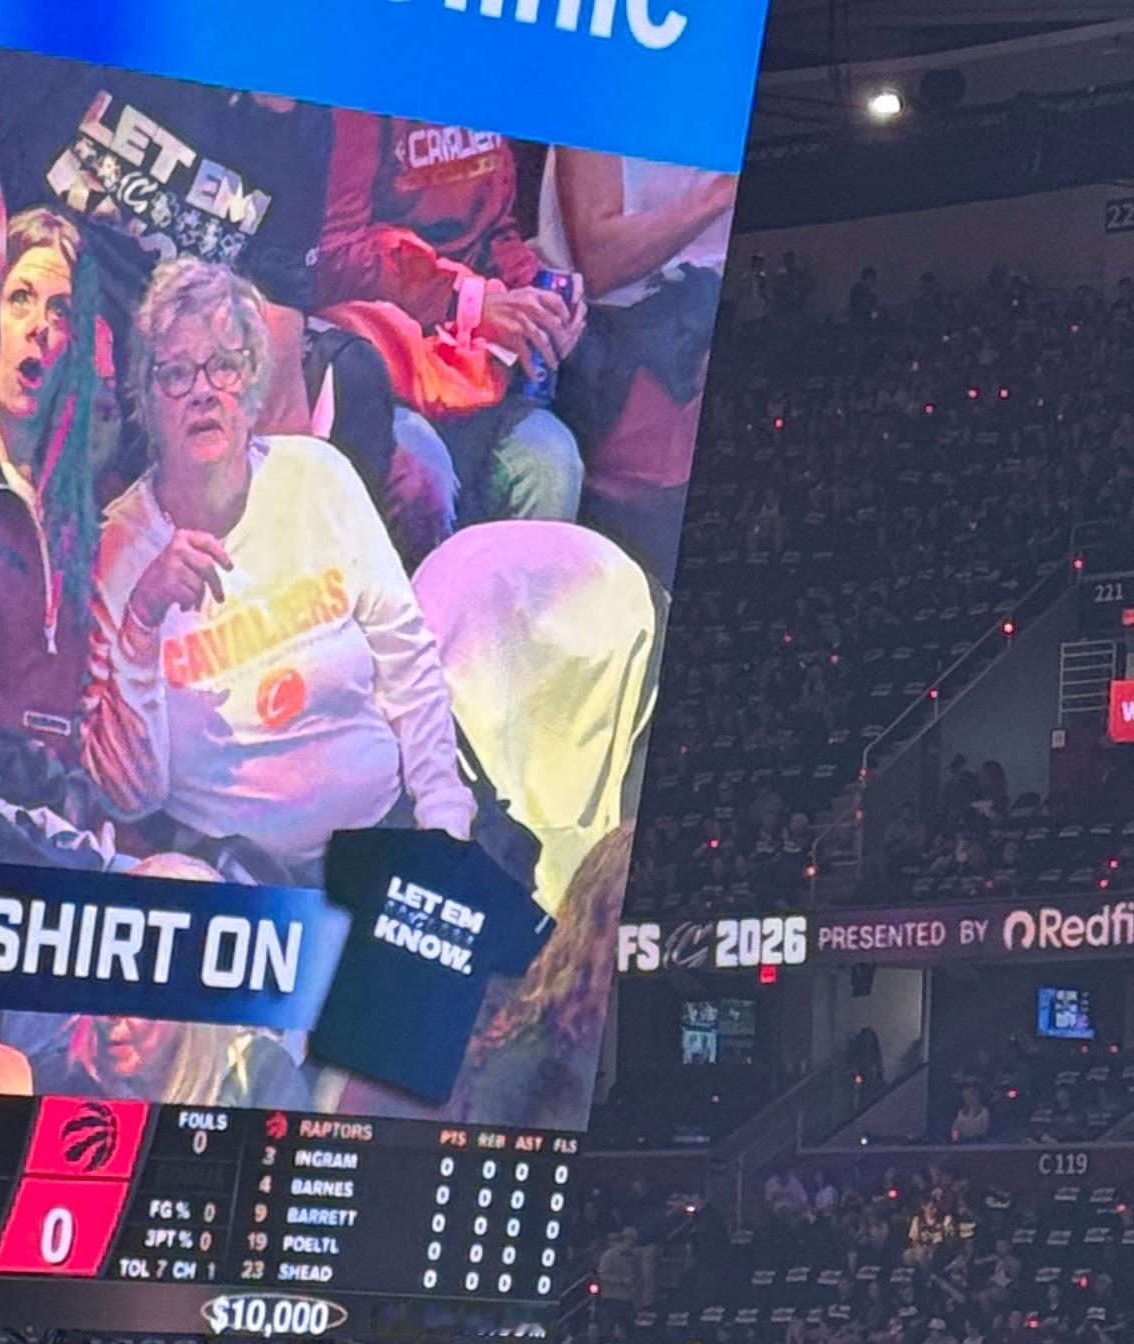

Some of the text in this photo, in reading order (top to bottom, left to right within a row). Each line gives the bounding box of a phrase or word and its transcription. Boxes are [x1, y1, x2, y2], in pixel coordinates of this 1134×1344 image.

[79, 89, 197, 185] LET
[185, 157, 272, 236] EM
[1094, 583, 1124, 603] 221
[386, 875, 486, 935] LET EM
[373, 913, 473, 976] KNOW.
[714, 915, 808, 970] 2026
[816, 920, 947, 951] PRESENTED
[959, 918, 992, 945] BY
[1039, 902, 1134, 951] Redfi
[200, 914, 305, 994] ON
[179, 1112, 227, 1133] FOULS
[301, 1120, 372, 1140] RAPTORS
[194, 1131, 207, 1153] 0
[263, 1147, 567, 1183] 3 INGRAM 0 0 0 0
[260, 1176, 563, 1211] 4 BARNES 0 0 0 0
[150, 1200, 215, 1222] FG % 0
[255, 1205, 559, 1239] 9 BARRETT 0 0 0 0
[40, 1208, 75, 1263] 0
[146, 1230, 211, 1250] 3PT % 0
[248, 1233, 339, 1253] 19 POELTL
[120, 1259, 215, 1279] TOL 7 CH 1
[242, 1261, 332, 1281] 23 SHEAD
[209, 1296, 330, 1338] $10,000
